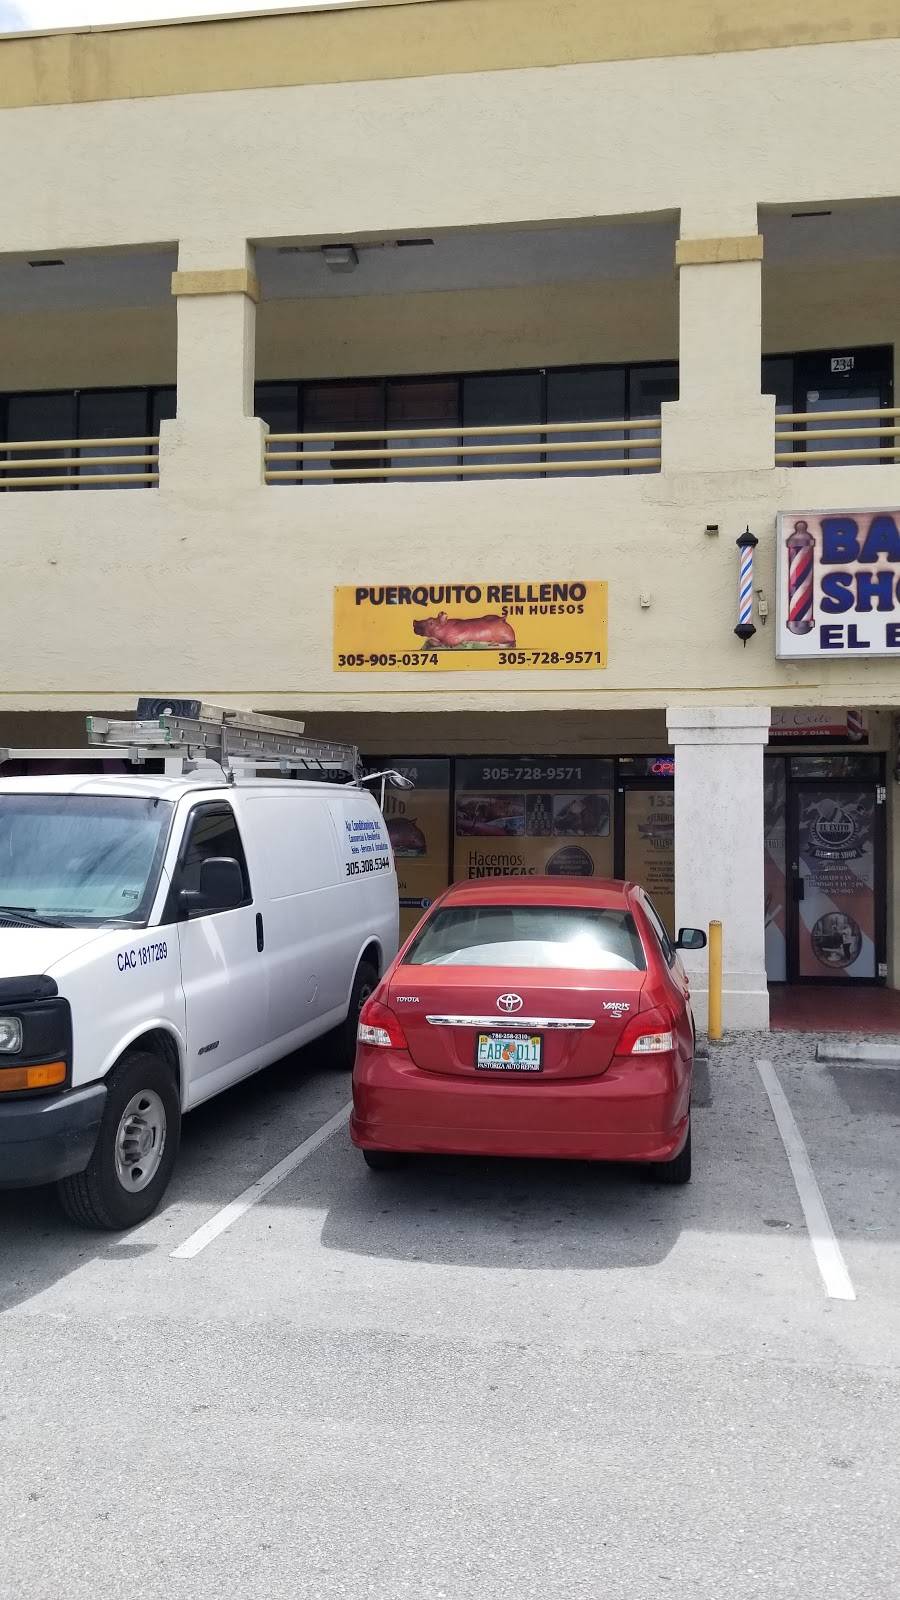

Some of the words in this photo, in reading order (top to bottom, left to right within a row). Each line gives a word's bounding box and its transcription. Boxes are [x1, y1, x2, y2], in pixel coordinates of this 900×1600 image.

[833, 358, 853, 370] 234
[355, 585, 482, 606] PUERQUITO
[486, 583, 588, 603] RELLENO
[820, 571, 900, 614] SH
[501, 605, 525, 616] SIN
[529, 604, 585, 615] HUESOS
[820, 624, 871, 649] EL
[338, 653, 438, 667] 305-905-0374
[498, 651, 601, 665] 305-728-9571
[482, 768, 582, 780] 305-728-9571
[346, 857, 389, 876] 305.308.5344
[117, 950, 137, 971] CAC
[138, 942, 168, 966] 1817289
[602, 1001, 631, 1011] YARIS
[610, 1010, 622, 1018] S
